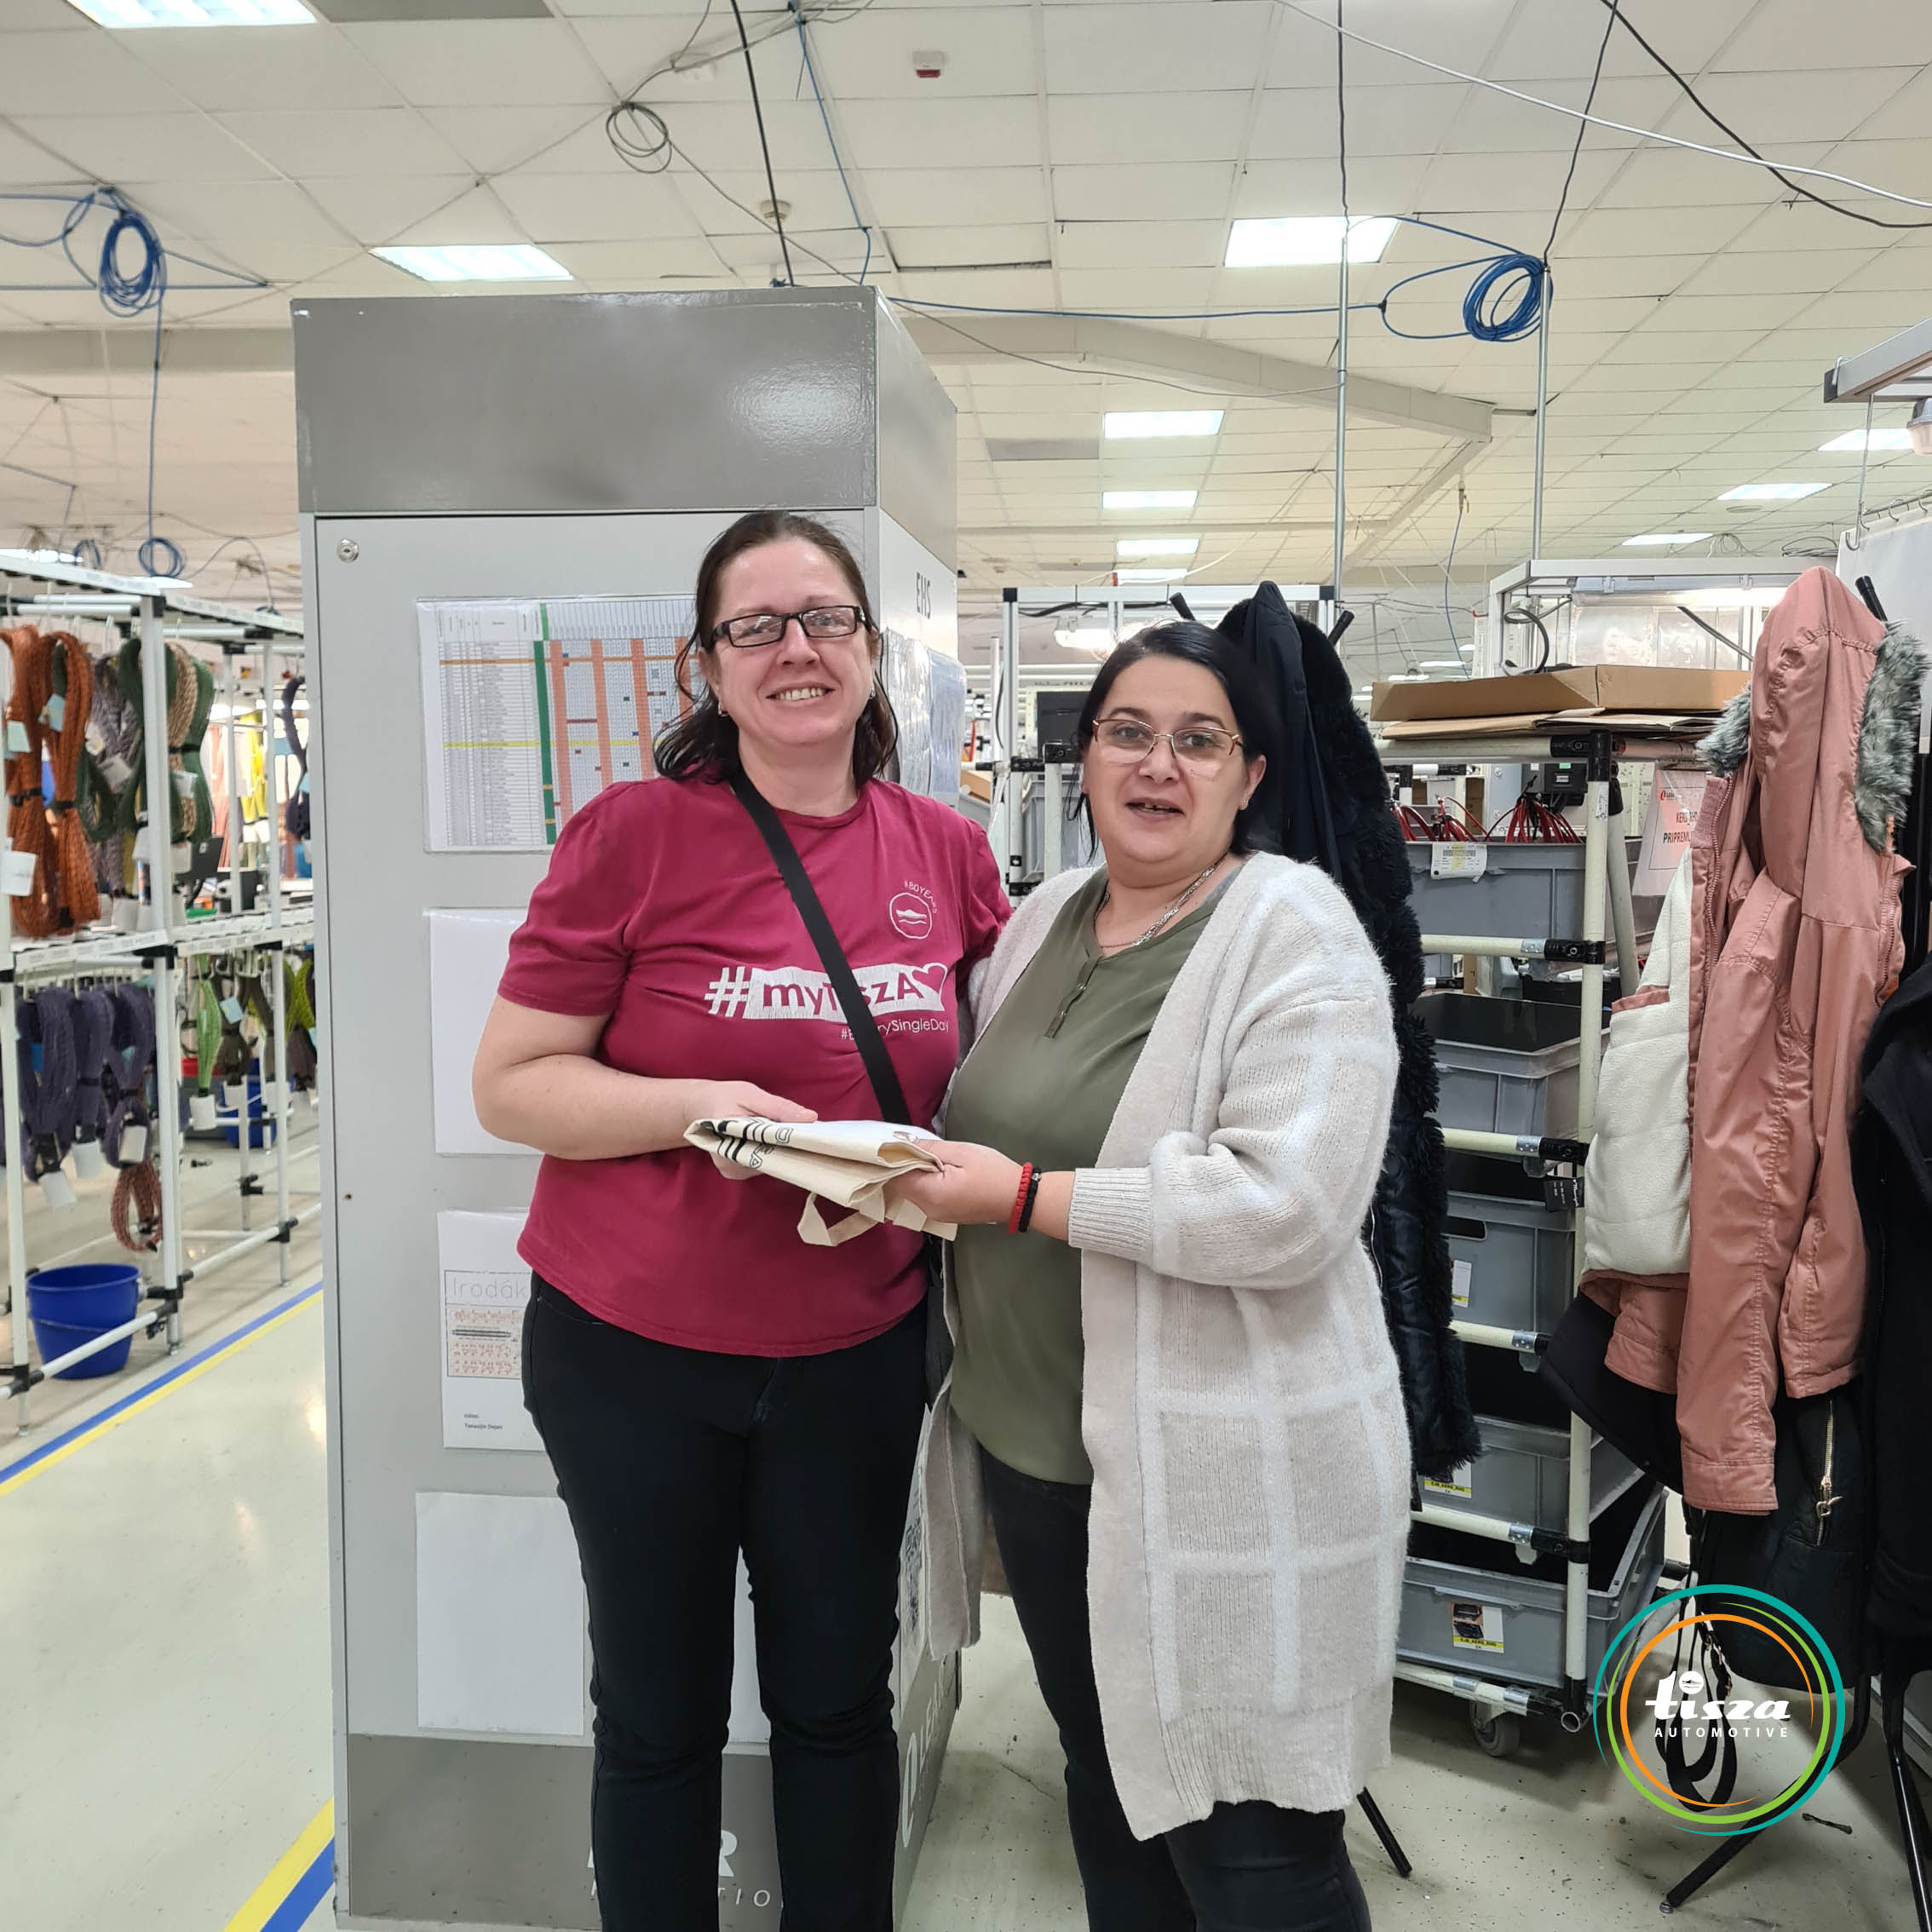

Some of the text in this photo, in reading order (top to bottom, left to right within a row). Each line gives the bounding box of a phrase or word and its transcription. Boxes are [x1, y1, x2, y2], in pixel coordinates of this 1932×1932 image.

[916, 572, 932, 620] EHS
[704, 966, 923, 1018] #myTszA
[841, 1019, 949, 1041] #ErySingleDay
